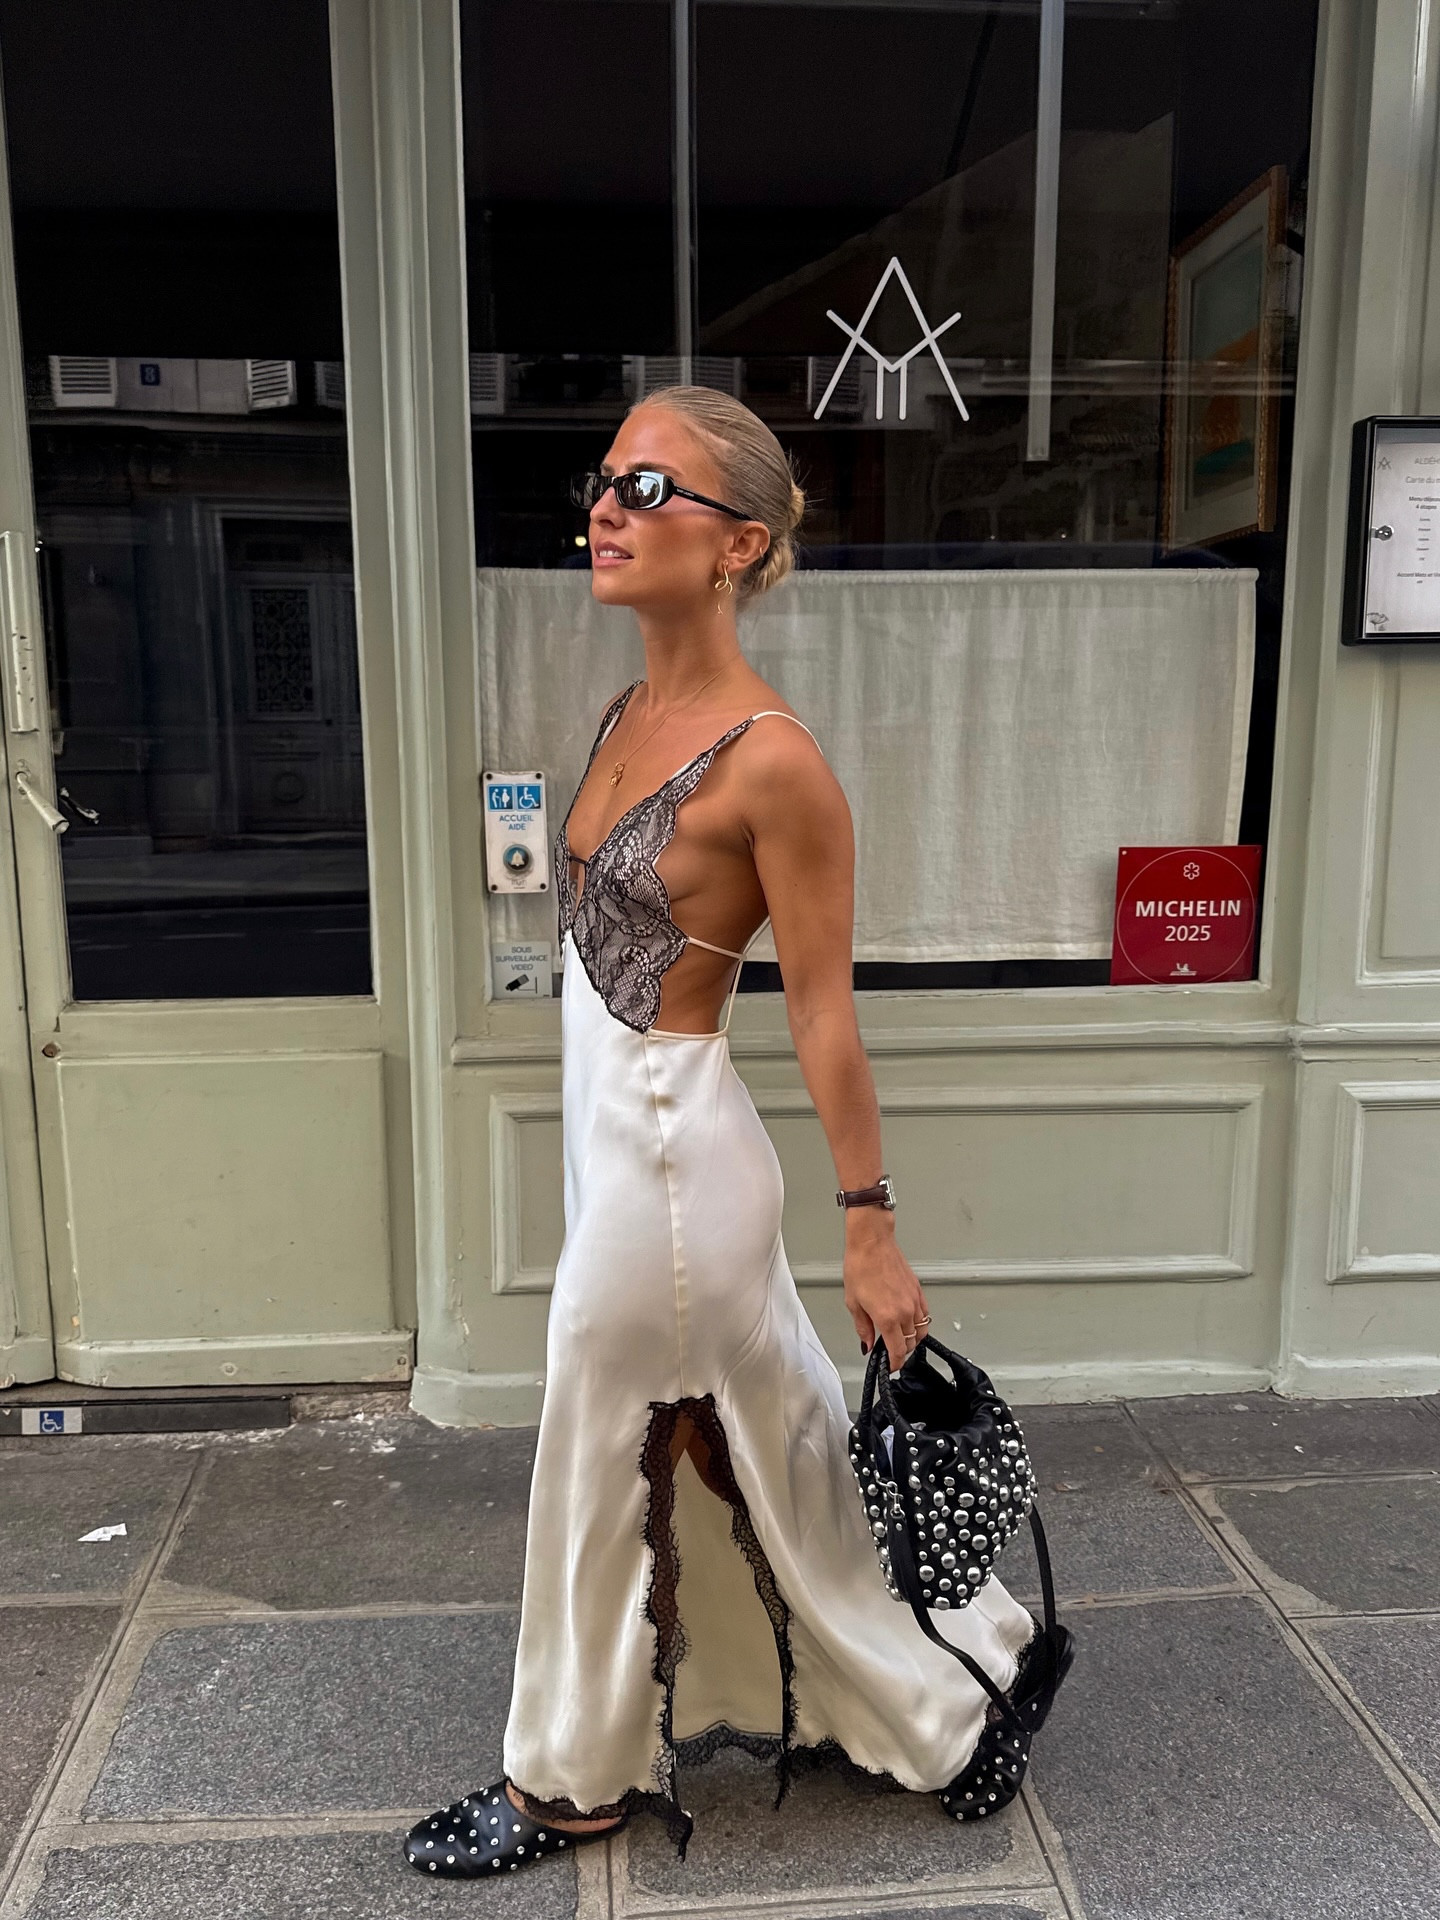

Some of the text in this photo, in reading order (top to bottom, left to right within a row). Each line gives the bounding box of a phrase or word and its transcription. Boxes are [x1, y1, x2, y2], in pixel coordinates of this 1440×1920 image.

[499, 814, 535, 822] ACCUEIL
[508, 823, 527, 831] AIDE
[1135, 900, 1241, 917] MICHELIN
[1164, 925, 1211, 942] 2025
[511, 946, 532, 954] SOUS
[495, 954, 548, 963] SURVEILLANCE
